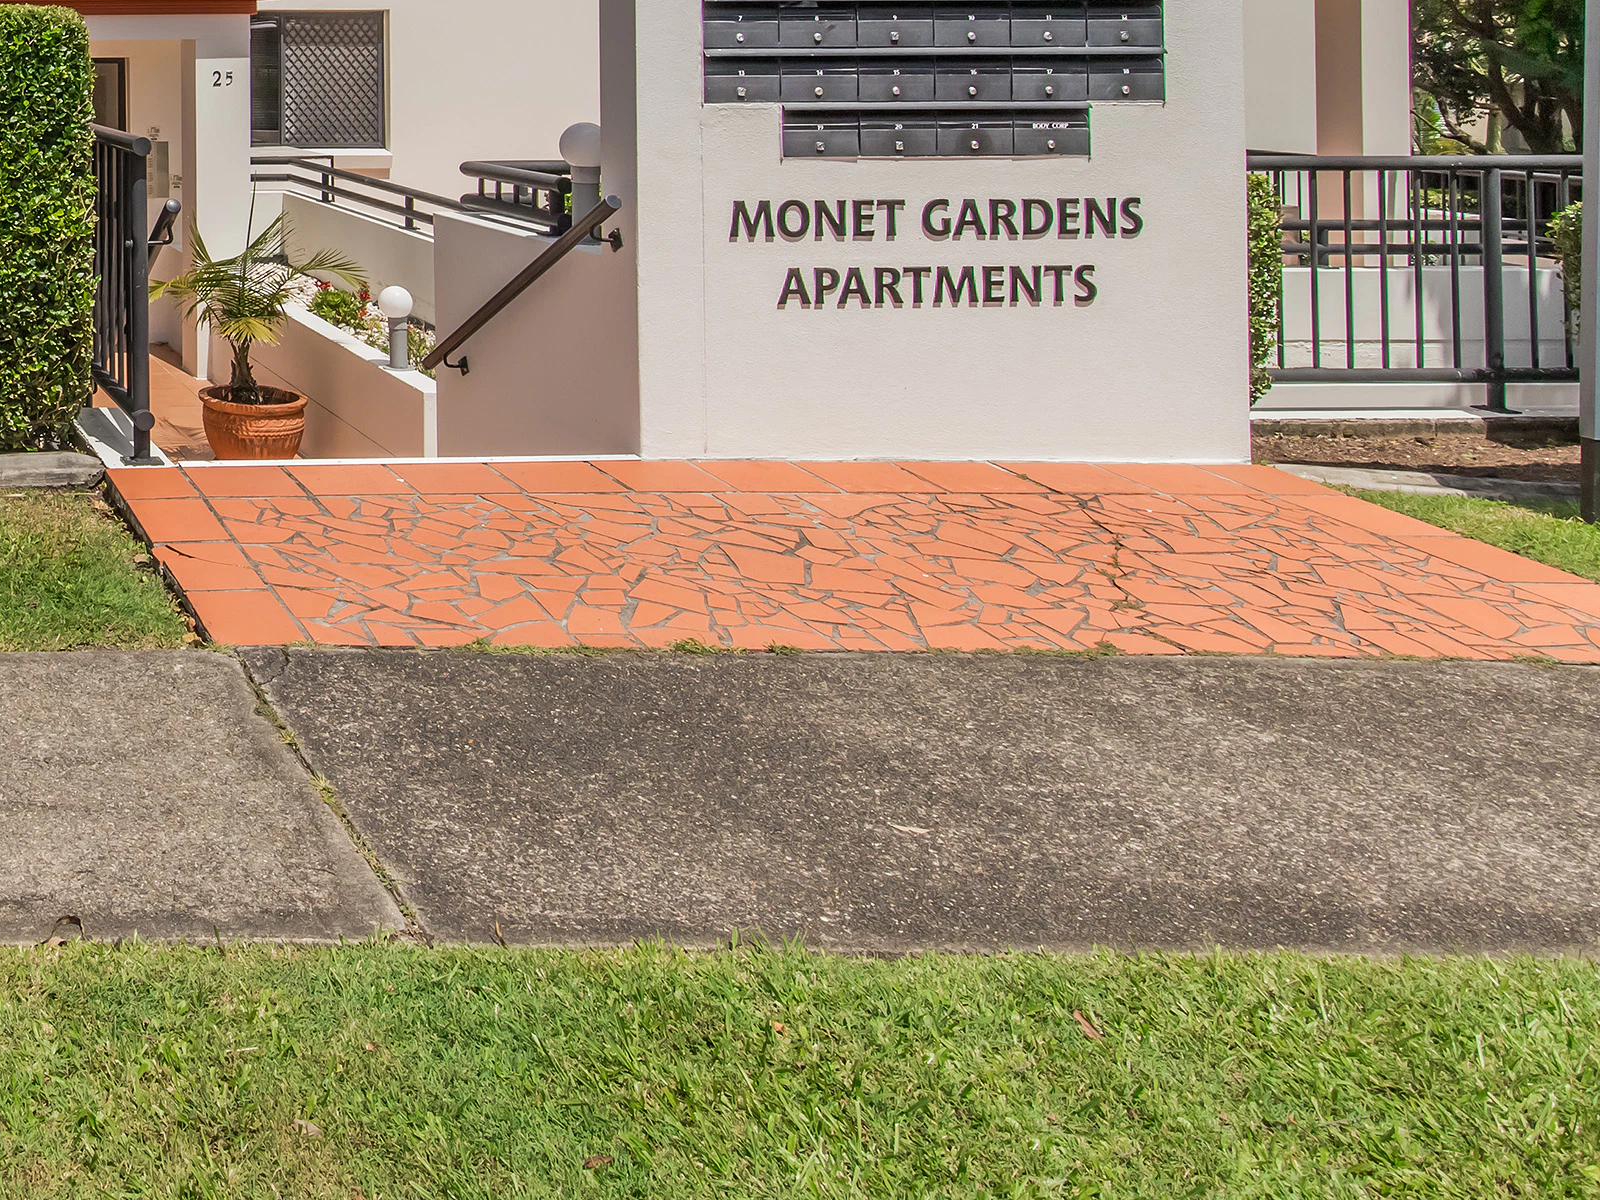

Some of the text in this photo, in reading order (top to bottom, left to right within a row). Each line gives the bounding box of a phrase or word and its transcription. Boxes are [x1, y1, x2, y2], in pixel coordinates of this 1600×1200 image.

[212, 70, 233, 87] 25
[737, 69, 746, 77] 13
[729, 197, 1144, 241] MONET GARDENS
[777, 264, 1098, 308] APARTMENTS
